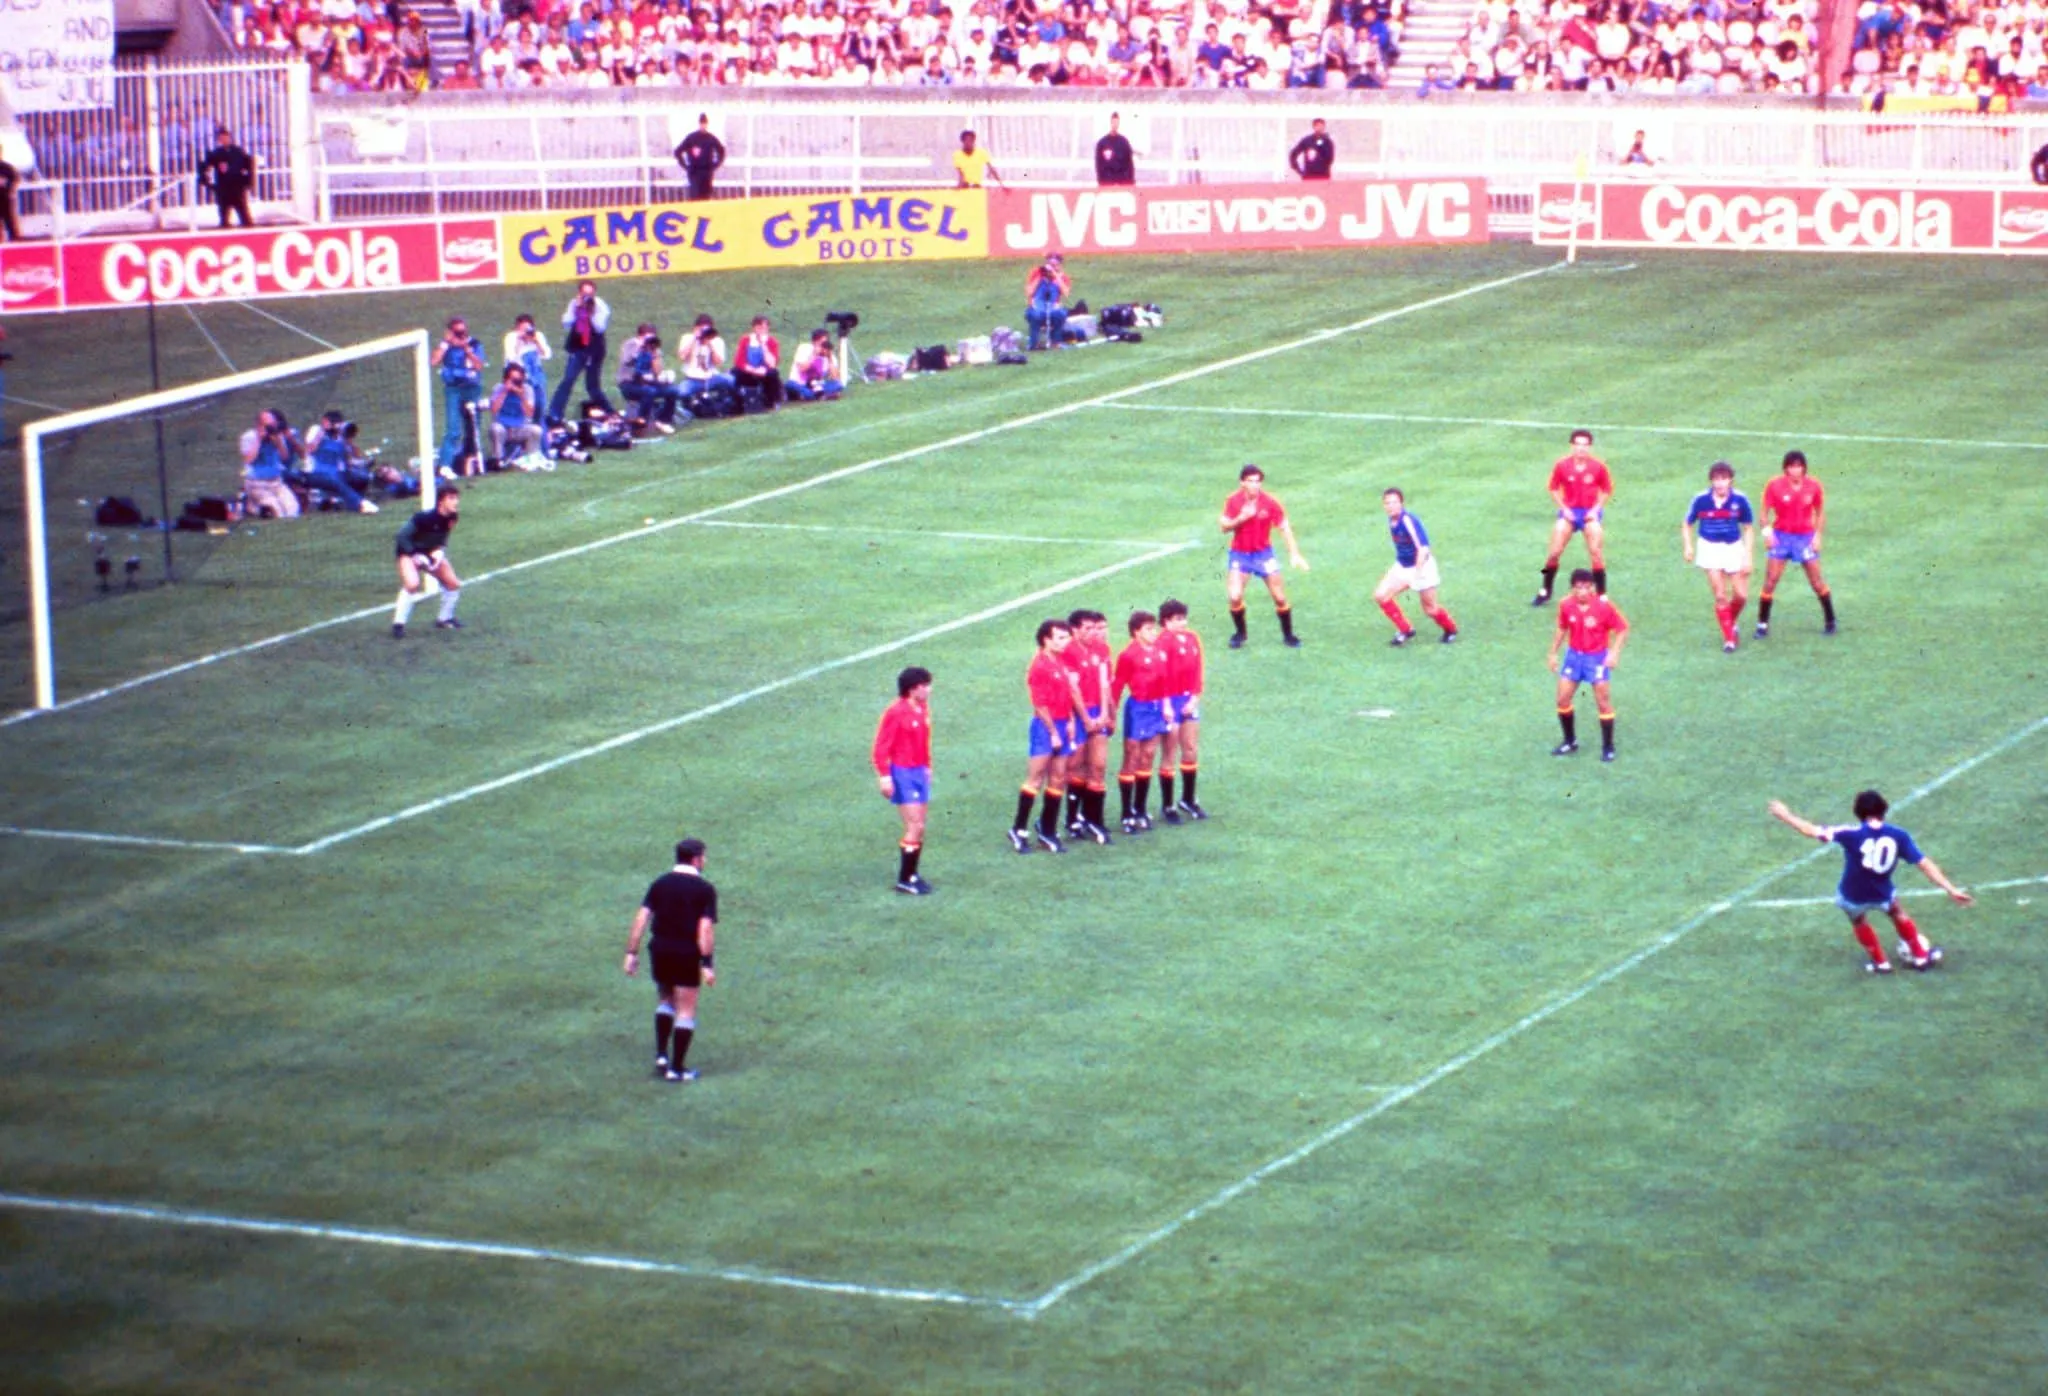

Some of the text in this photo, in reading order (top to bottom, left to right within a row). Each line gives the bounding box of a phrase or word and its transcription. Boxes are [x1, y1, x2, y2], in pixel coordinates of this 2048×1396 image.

[519, 209, 724, 265] CAMEL
[762, 197, 968, 249] CAMEL
[1005, 191, 1138, 249] JVC
[1213, 195, 1326, 233] VIDEO
[1340, 182, 1472, 240] JVC
[1640, 184, 1952, 247] Coca-Cola
[103, 229, 401, 301] Coca-Cola
[575, 251, 670, 275] BOOTS
[818, 238, 914, 261] BOOTS
[1859, 836, 1898, 874] 10
